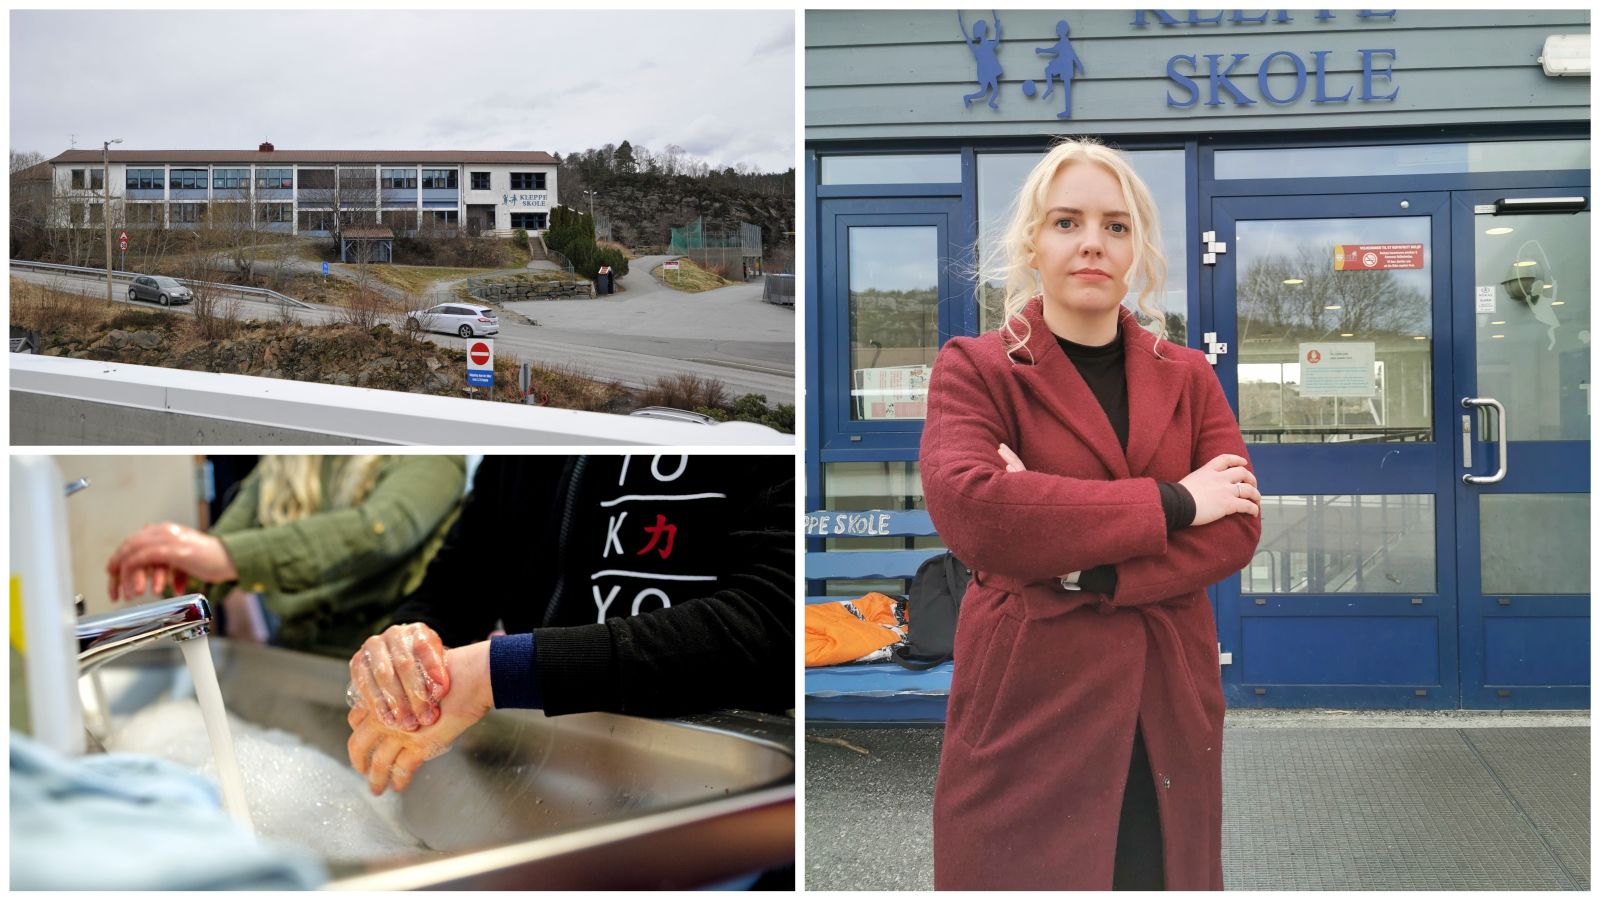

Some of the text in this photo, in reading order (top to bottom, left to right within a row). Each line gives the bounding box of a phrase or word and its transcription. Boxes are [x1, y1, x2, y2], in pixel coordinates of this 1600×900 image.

[1166, 48, 1400, 107] SKOLE
[602, 511, 677, 560] K 力
[834, 514, 891, 535] SKOLE
